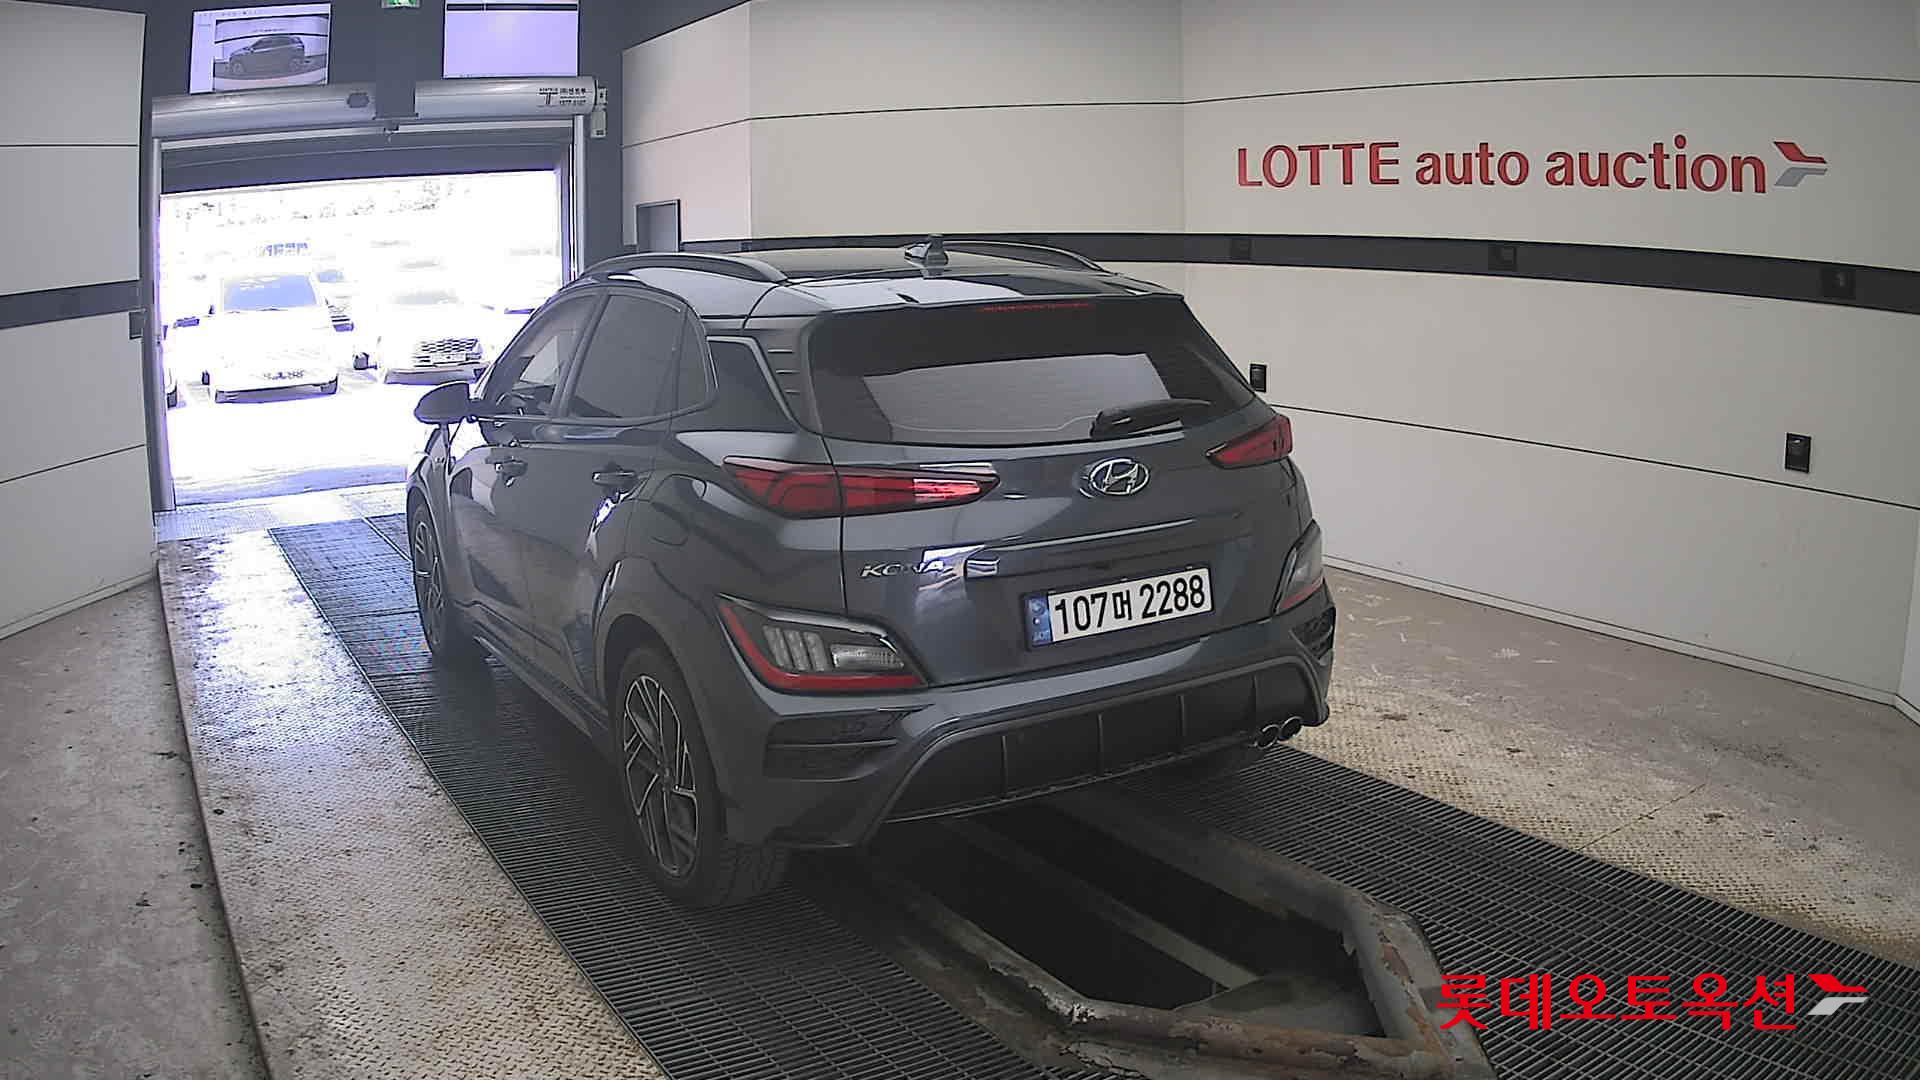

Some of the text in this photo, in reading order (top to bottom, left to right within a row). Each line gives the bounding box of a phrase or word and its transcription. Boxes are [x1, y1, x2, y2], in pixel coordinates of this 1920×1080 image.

[1237, 133, 1767, 195] LOTTE auto auction
[1055, 575, 1205, 634] 107머 2288
